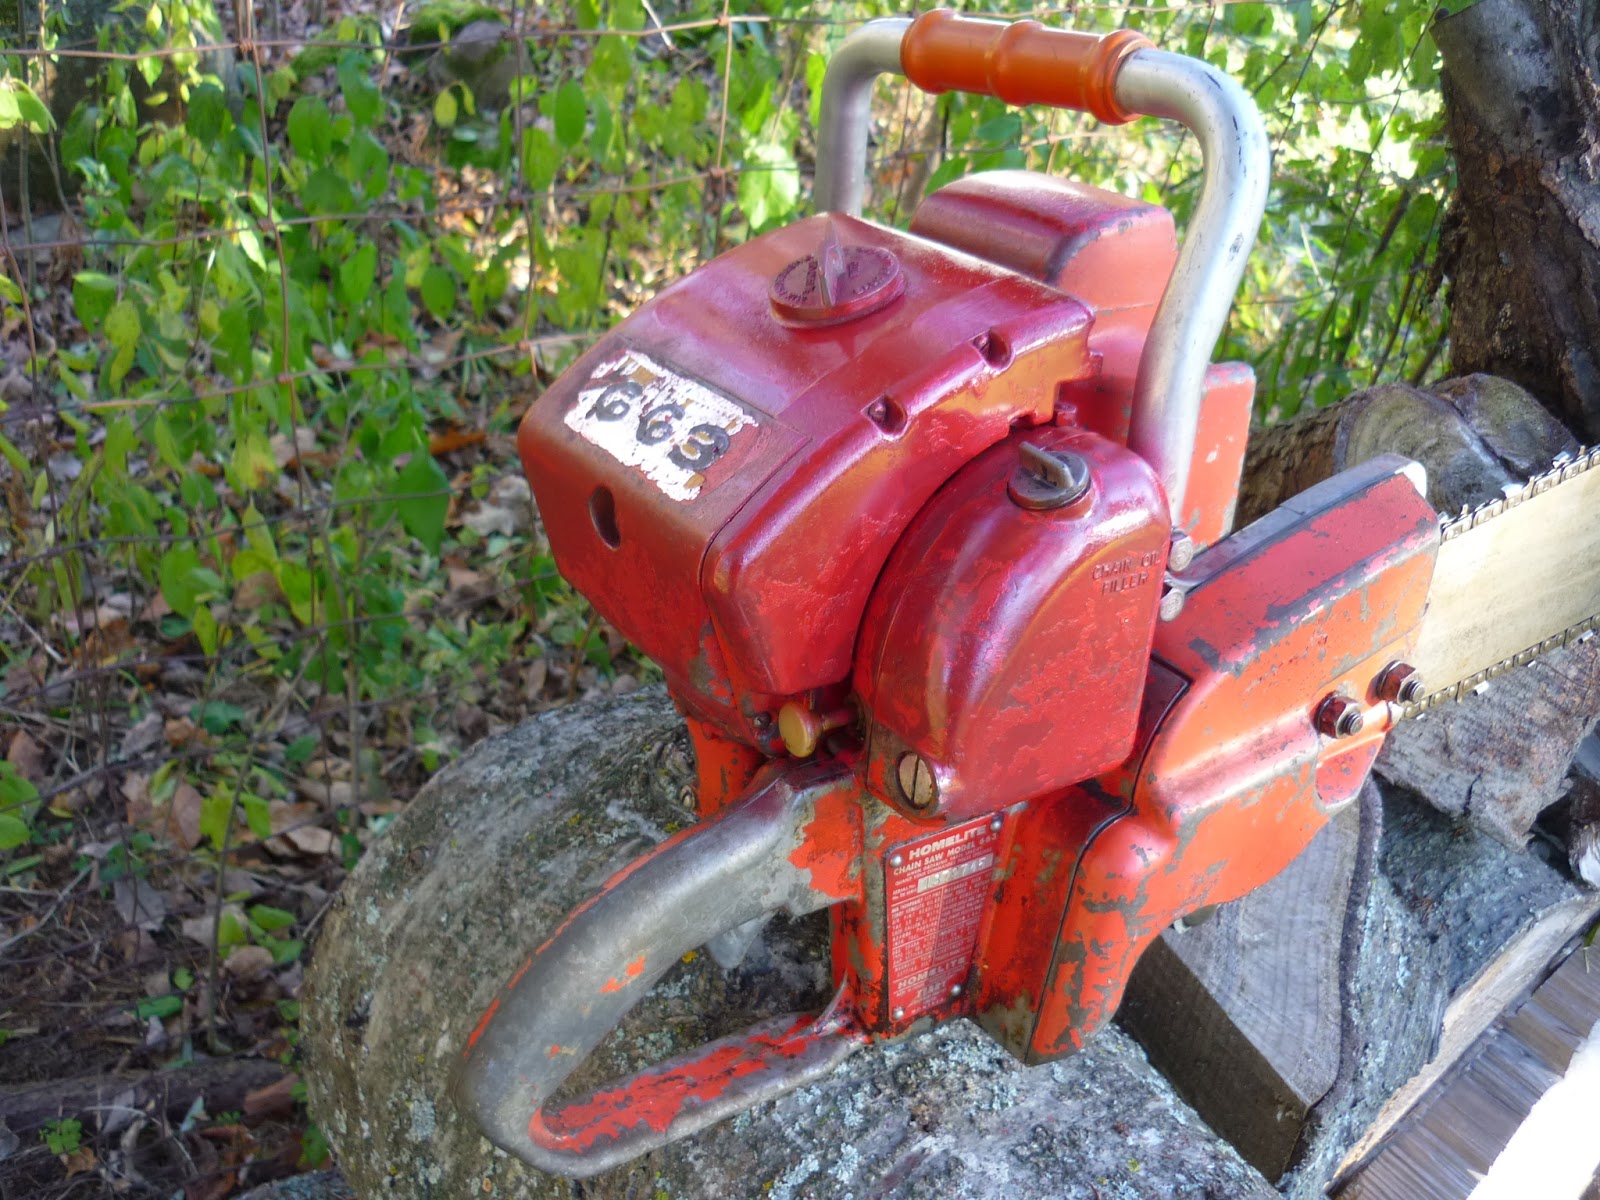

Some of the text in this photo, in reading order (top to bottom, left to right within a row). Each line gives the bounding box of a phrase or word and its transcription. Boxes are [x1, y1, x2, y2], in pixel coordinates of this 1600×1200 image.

[585, 381, 731, 471] 663
[1092, 549, 1160, 580] CHAIN OIL
[1101, 572, 1148, 596] FILLER
[893, 833, 997, 876] CHAIN SAW MODEL 663
[909, 825, 987, 860] HOMELITE
[897, 957, 966, 990] HOMELITE
